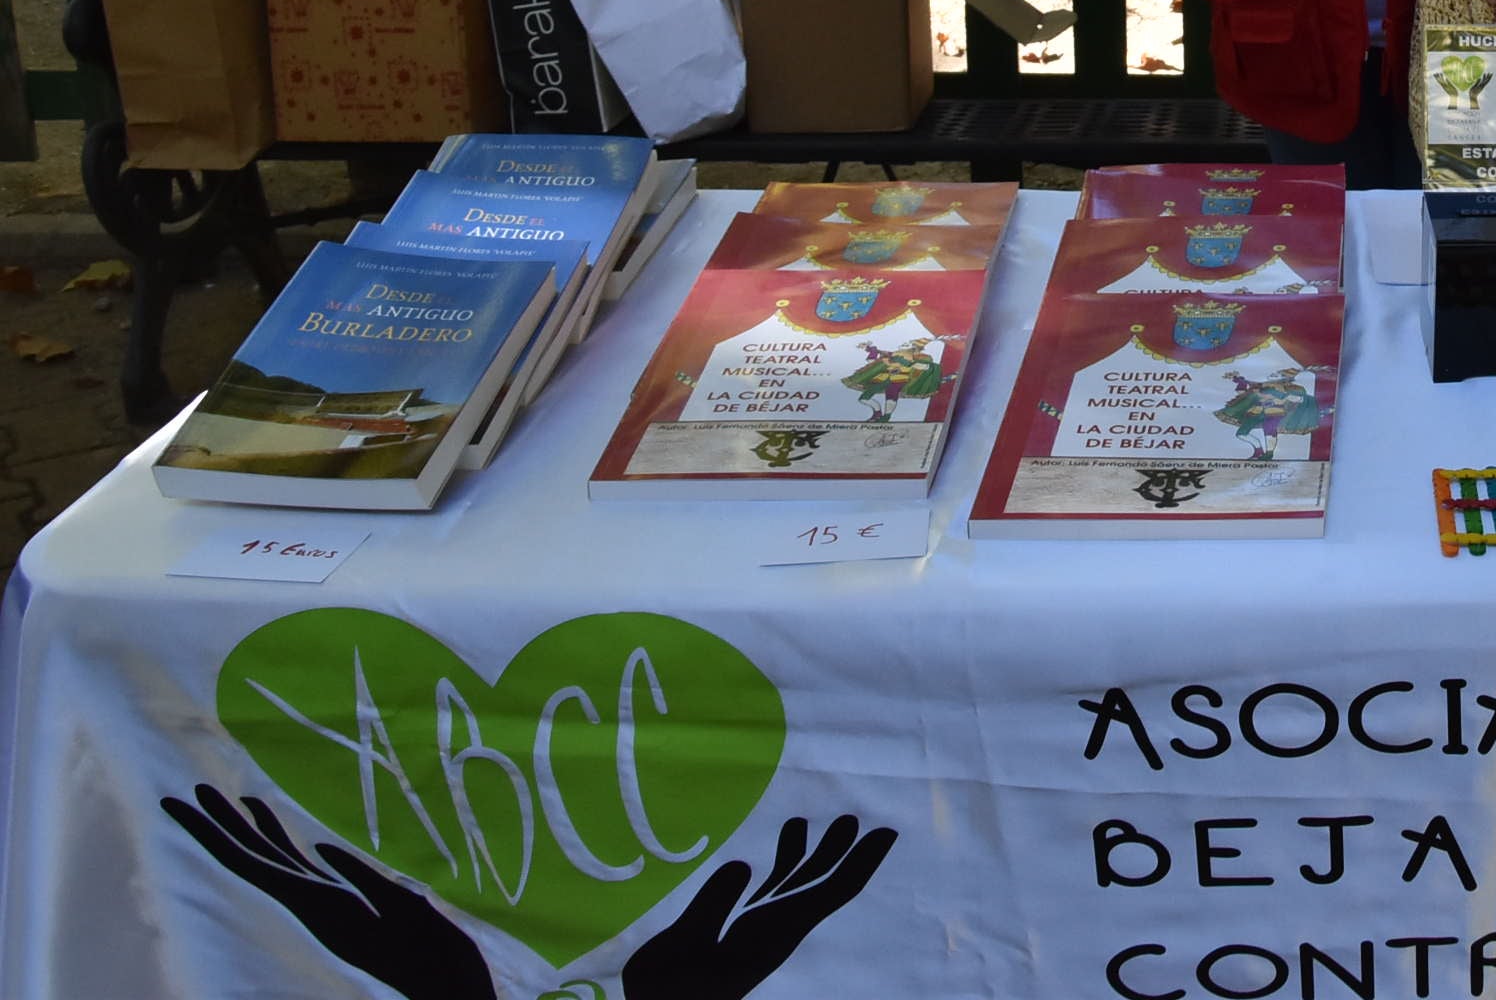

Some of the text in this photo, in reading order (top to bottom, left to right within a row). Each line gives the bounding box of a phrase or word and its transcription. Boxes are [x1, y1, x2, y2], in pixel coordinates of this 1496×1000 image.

[496, 160, 557, 173] DESDE
[504, 176, 596, 186] ANTIGUO
[464, 207, 529, 225] DESDE
[467, 226, 565, 241] ANTIGUO
[366, 283, 436, 303] DESDE
[367, 304, 474, 321] ANTIGUO
[298, 311, 473, 343] BURLADERO
[743, 342, 827, 352] CULTURA
[744, 355, 822, 364] TEATRAL
[1103, 371, 1193, 382] CULTURA
[758, 379, 785, 388] EN
[1107, 385, 1190, 395] TEATRAL
[707, 391, 820, 401] LA CIUDAD
[713, 400, 809, 413] DE BÉJAR
[1088, 398, 1202, 408] MUSICAL...
[1128, 411, 1156, 421] EN
[693, 423, 714, 431] Luis
[716, 423, 770, 431] Fernando
[807, 423, 822, 431] de
[1076, 424, 1195, 435] LA CIUDAD
[1085, 435, 1186, 450] DE BÉJAR
[1068, 459, 1090, 467] Luis
[1092, 460, 1149, 468] Fernando
[1188, 461, 1205, 469] de
[1207, 461, 1241, 469] Miera
[797, 522, 884, 546] 15 €
[242, 539, 275, 555] 15
[244, 645, 710, 907] ABCC
